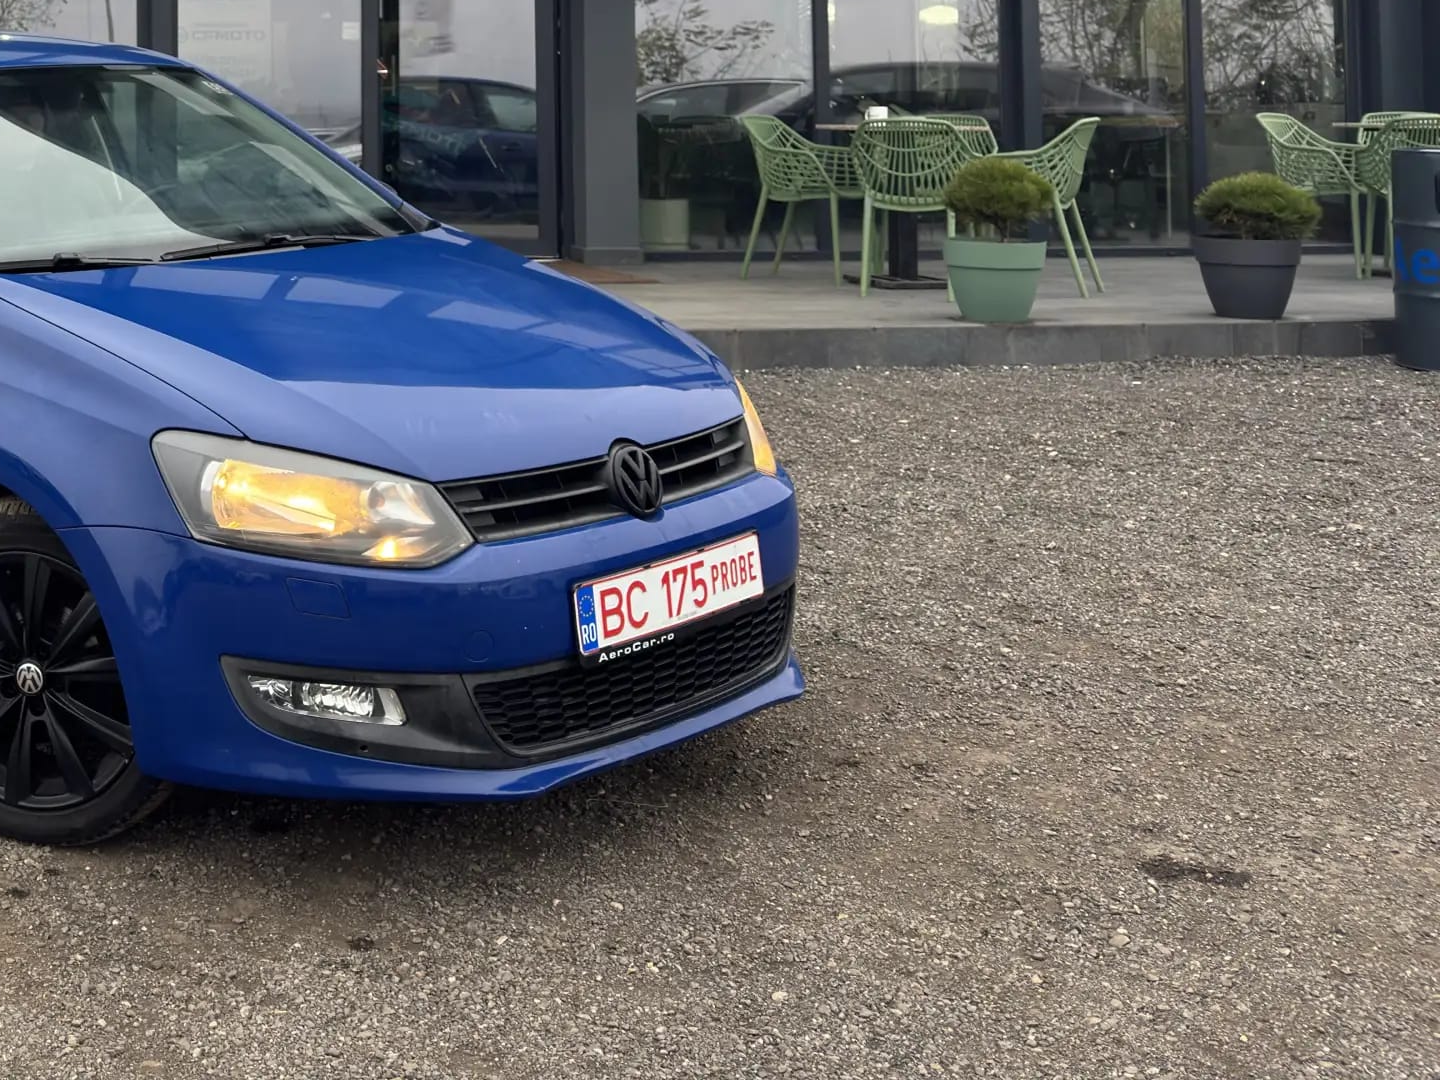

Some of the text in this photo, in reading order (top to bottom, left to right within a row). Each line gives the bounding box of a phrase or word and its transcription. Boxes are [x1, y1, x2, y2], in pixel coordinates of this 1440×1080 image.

[600, 551, 758, 639] BC 175 PROBE
[581, 622, 597, 645] RO
[599, 633, 675, 663] AeroCar.ro
